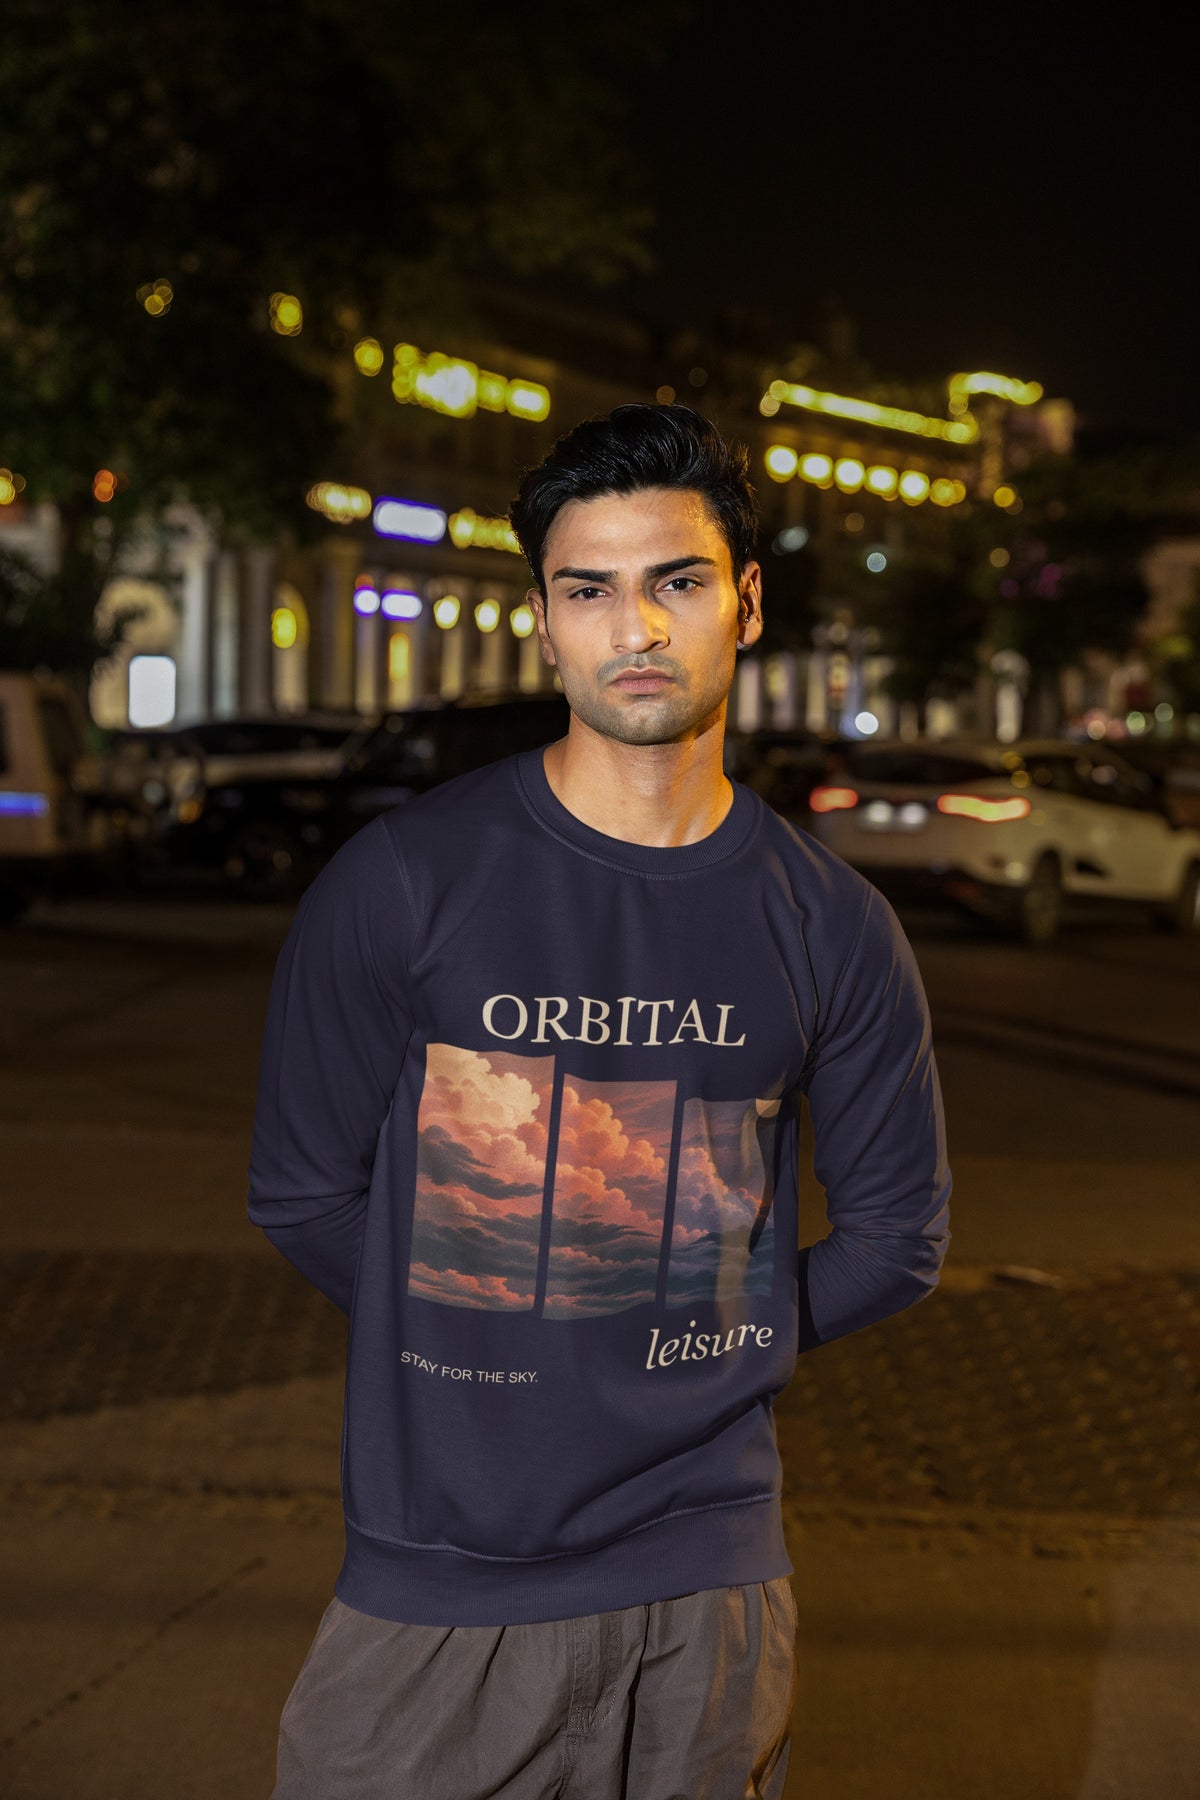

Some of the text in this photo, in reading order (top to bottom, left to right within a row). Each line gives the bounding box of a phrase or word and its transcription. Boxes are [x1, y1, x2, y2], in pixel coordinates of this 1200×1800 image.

[481, 994, 746, 1047] ORBITAL
[400, 1351, 538, 1384] STAY FOR THE SKY.
[645, 1320, 774, 1370] leisure
